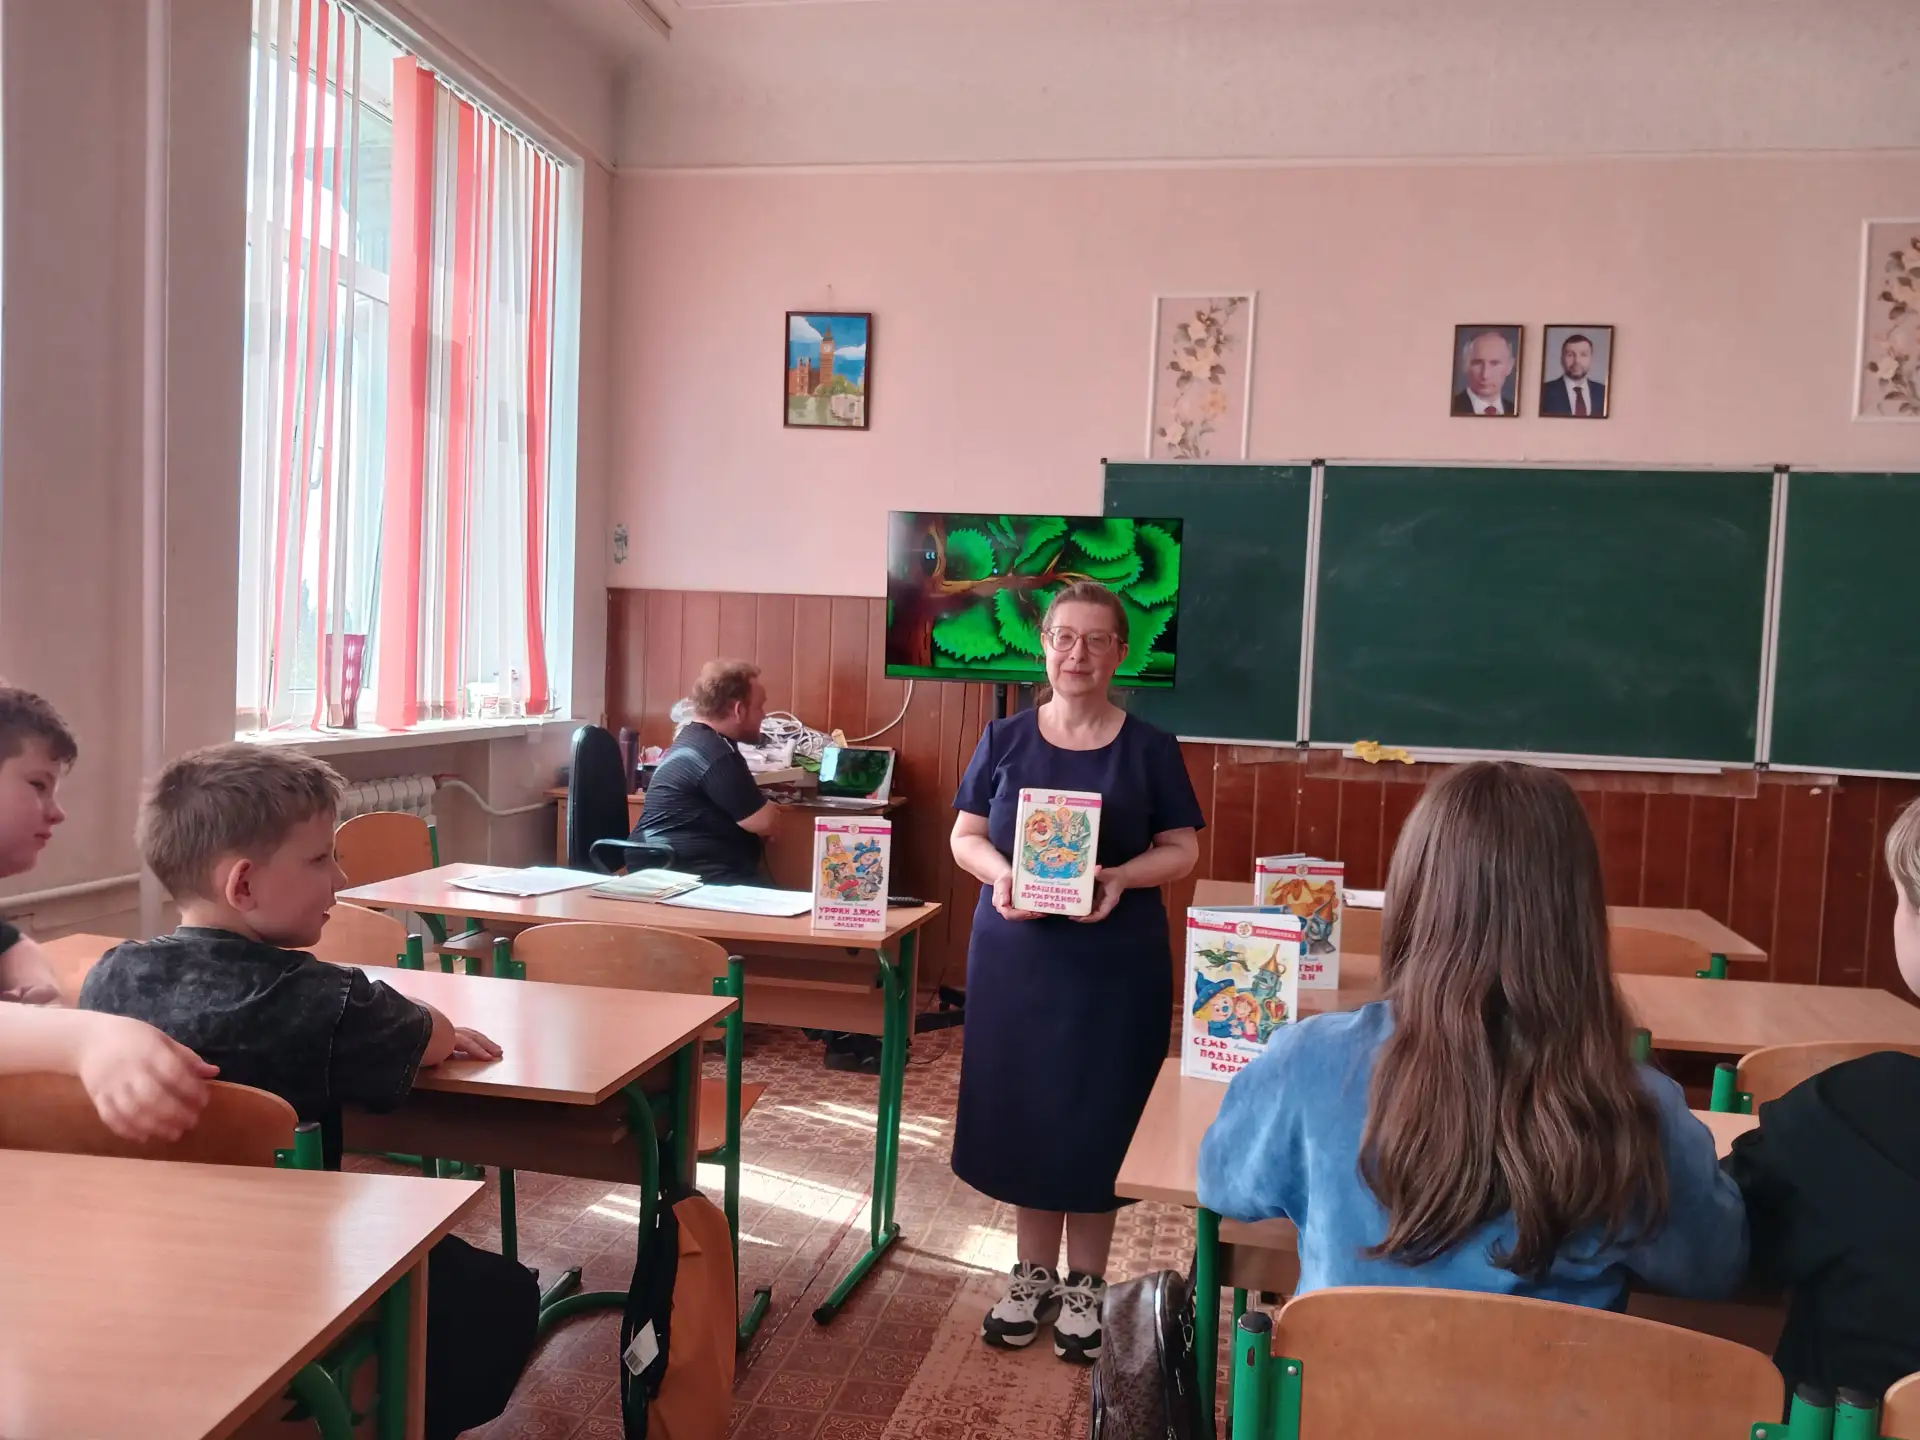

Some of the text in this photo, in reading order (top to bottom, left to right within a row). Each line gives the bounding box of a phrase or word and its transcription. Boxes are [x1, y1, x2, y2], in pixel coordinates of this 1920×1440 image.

[1024, 884, 1079, 895] ВОЛШЕБНИК
[1021, 892, 1082, 904] ИЗУМРУДНОГО
[818, 906, 881, 916] УРФИН ДЖЮС
[1033, 901, 1067, 910] ГОРОДА
[1193, 1036, 1228, 1049] СЕМЬ
[1199, 1048, 1249, 1064] ПОДЗЕМ
